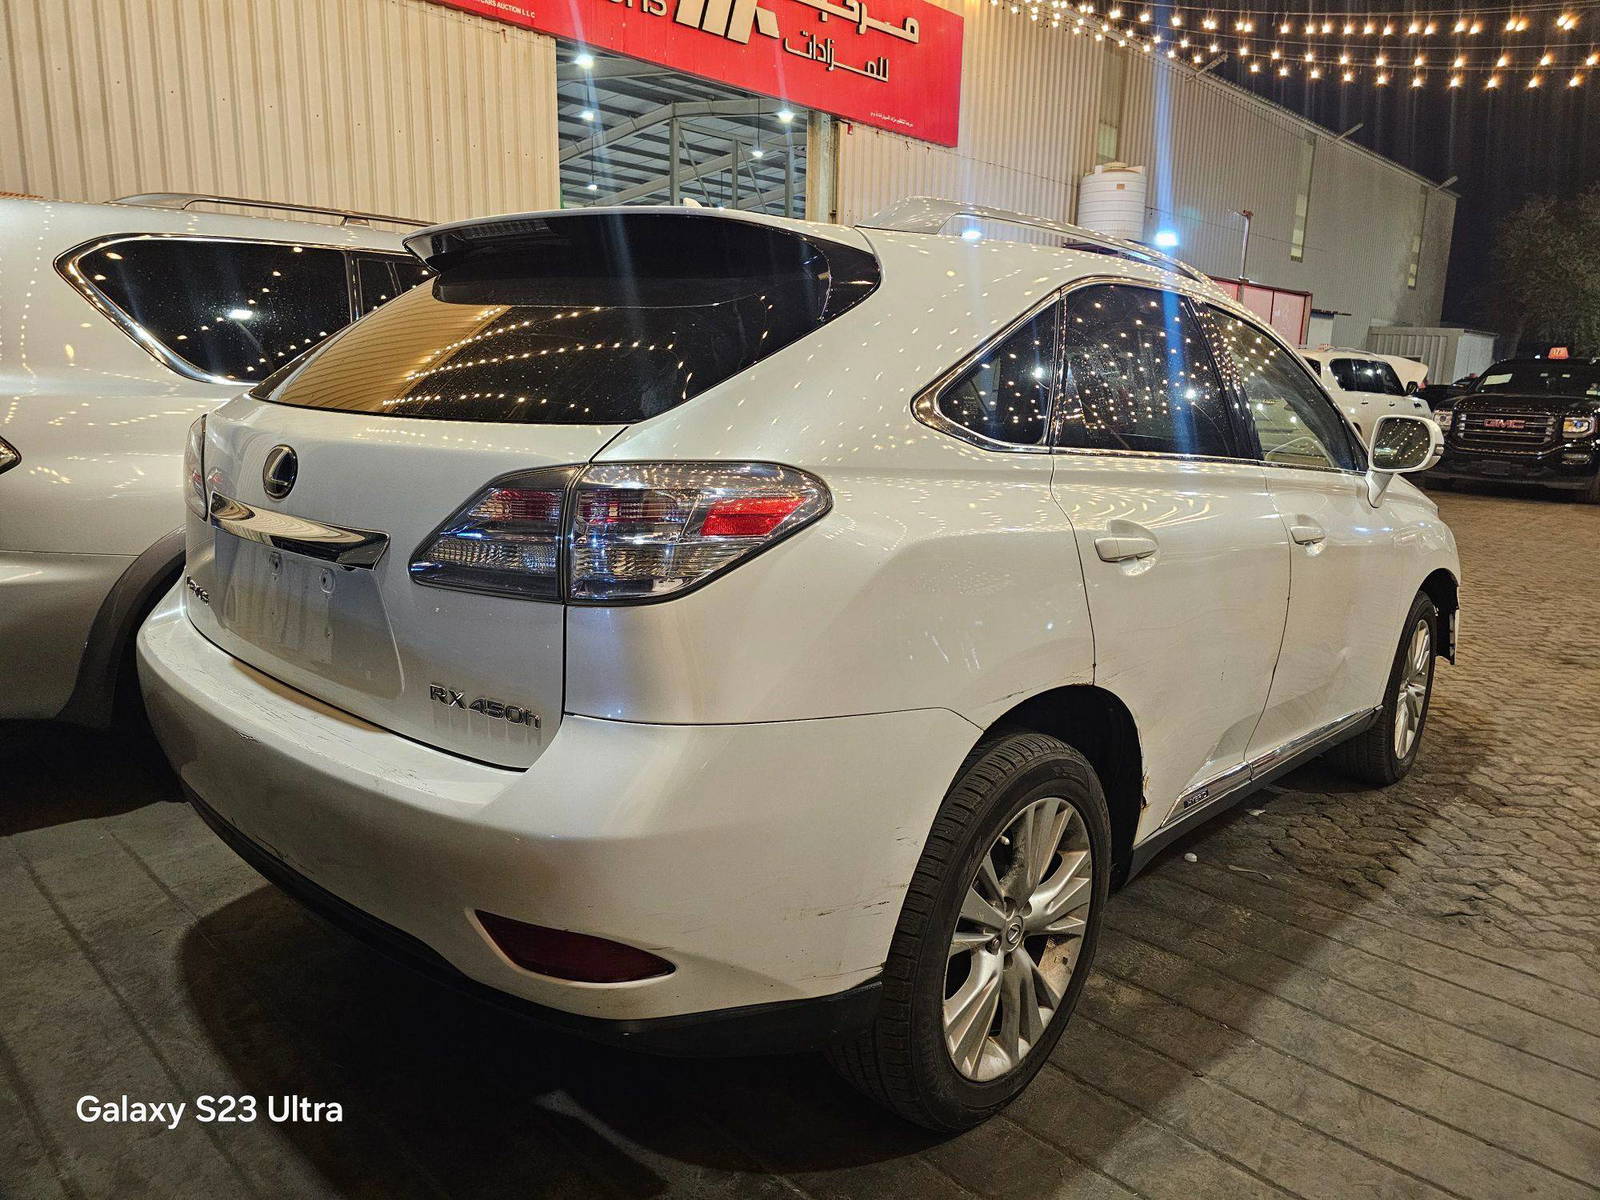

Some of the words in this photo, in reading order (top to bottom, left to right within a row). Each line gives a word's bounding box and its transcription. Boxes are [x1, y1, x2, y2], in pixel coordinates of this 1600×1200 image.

[497, 2, 521, 14] AUCTION
[784, 30, 889, 82] للمزادات
[1484, 418, 1525, 428] GMC
[430, 684, 467, 710] RX
[469, 697, 541, 729] 450h
